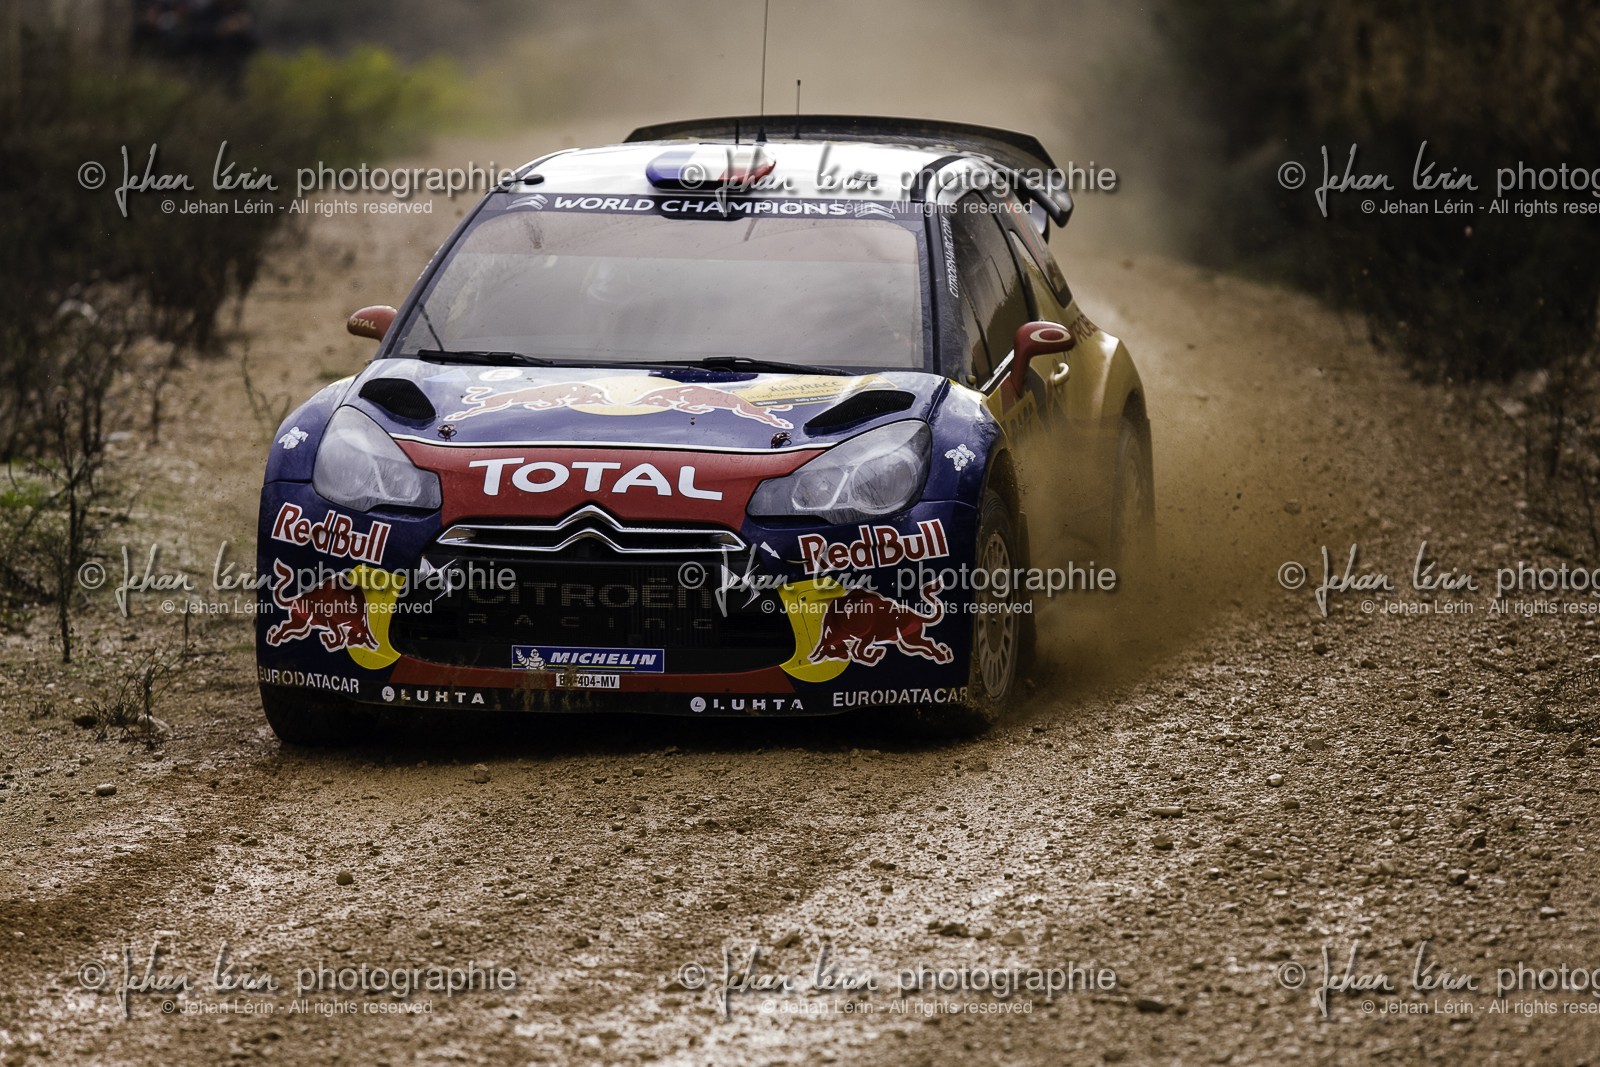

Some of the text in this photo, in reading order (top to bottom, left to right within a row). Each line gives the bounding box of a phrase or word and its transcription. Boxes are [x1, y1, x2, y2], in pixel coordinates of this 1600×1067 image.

[554, 196, 848, 215] WORLD CHAMPIONS
[468, 457, 723, 501] TOTAL
[468, 613, 712, 629] RACING
[550, 652, 656, 666] MICHELIN
[259, 665, 359, 694] EURODATACAR
[401, 688, 485, 704] LUHTA
[713, 698, 804, 711] LUHTA
[833, 687, 968, 707] EURODATACAR
